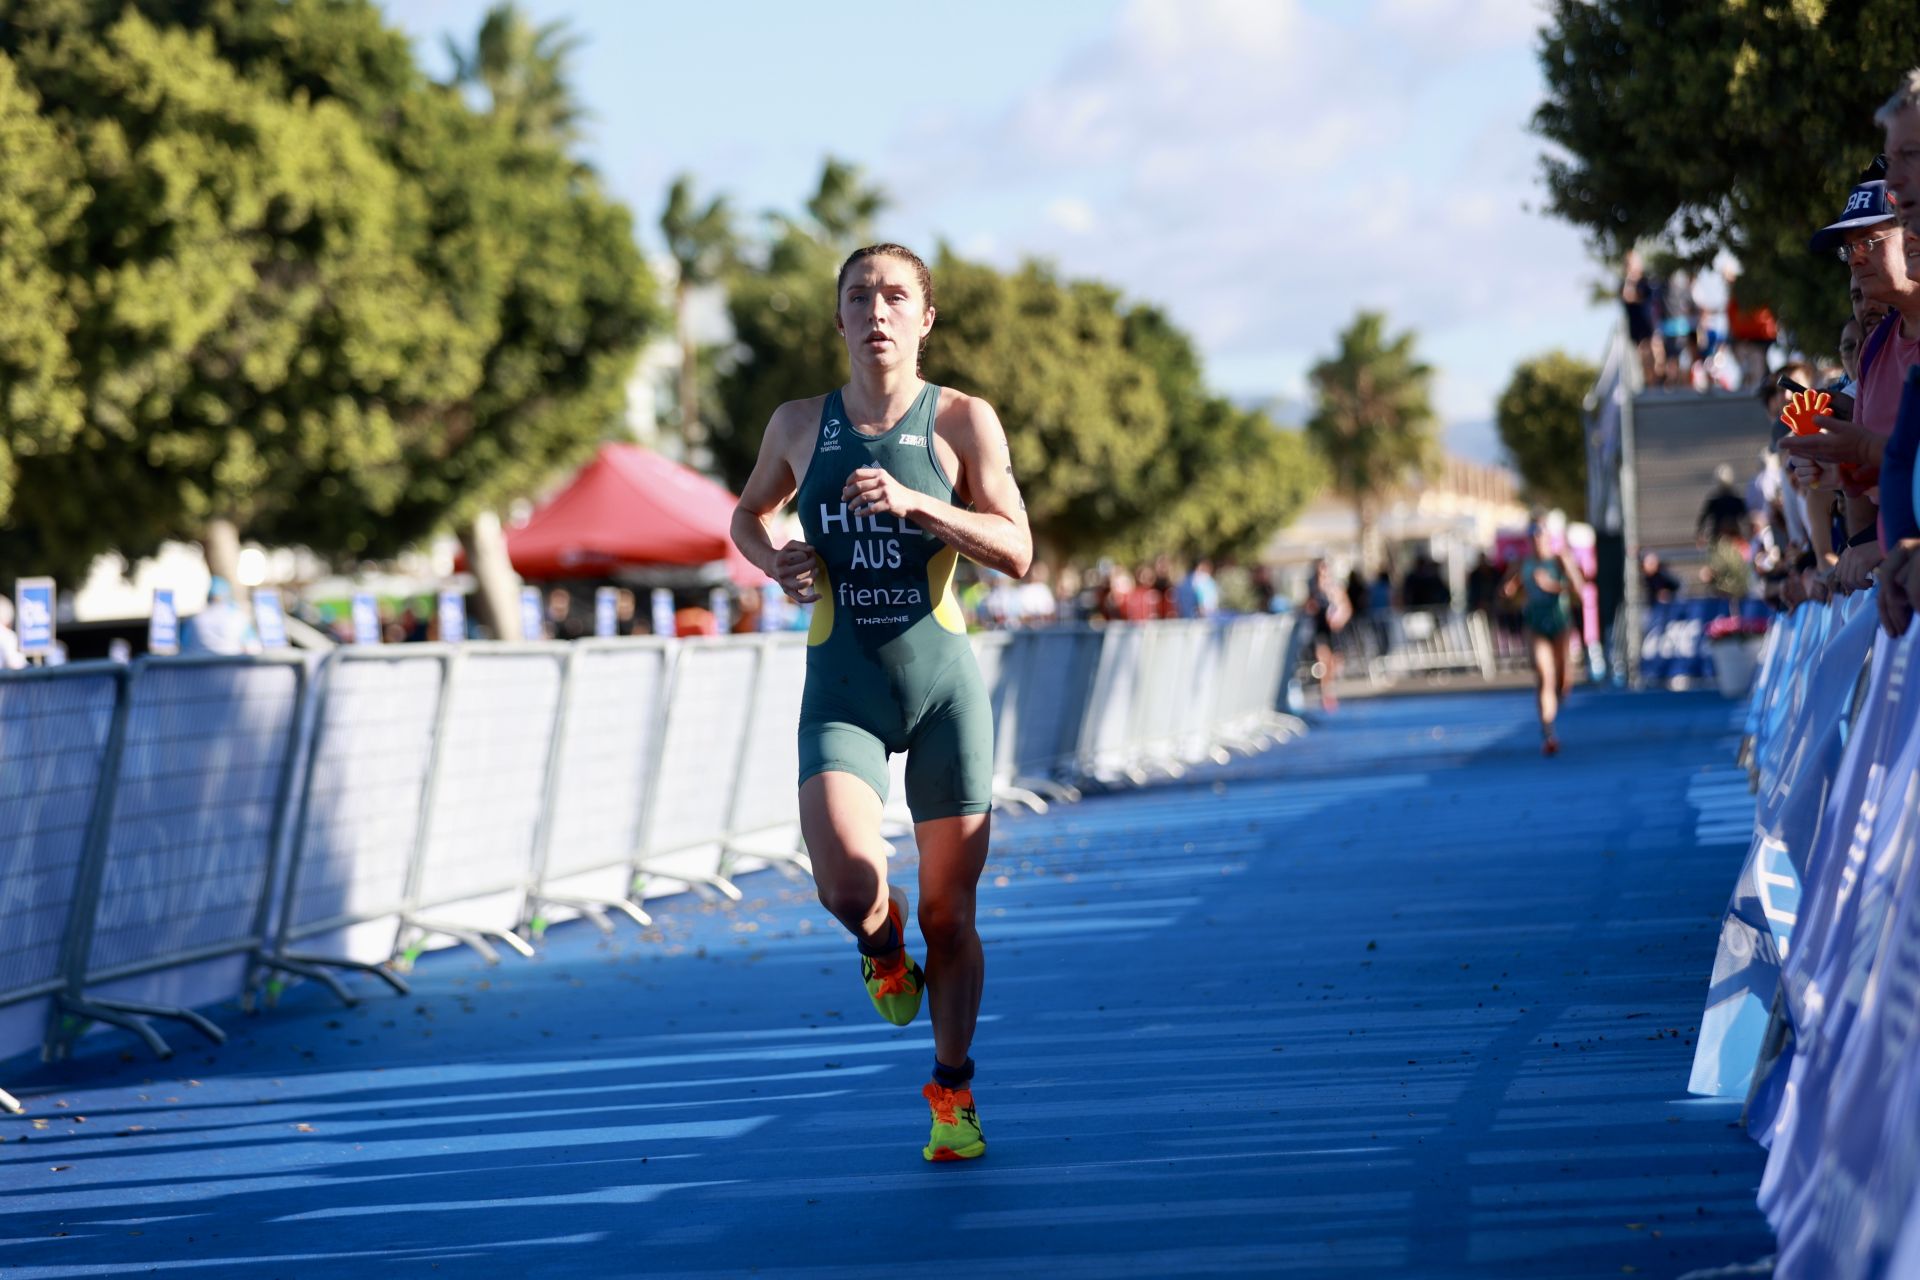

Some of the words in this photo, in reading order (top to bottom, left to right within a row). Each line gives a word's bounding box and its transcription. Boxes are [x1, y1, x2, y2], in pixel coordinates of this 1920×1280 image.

[820, 502, 923, 535] HILL
[851, 539, 901, 570] AUS
[838, 582, 922, 606] fienza
